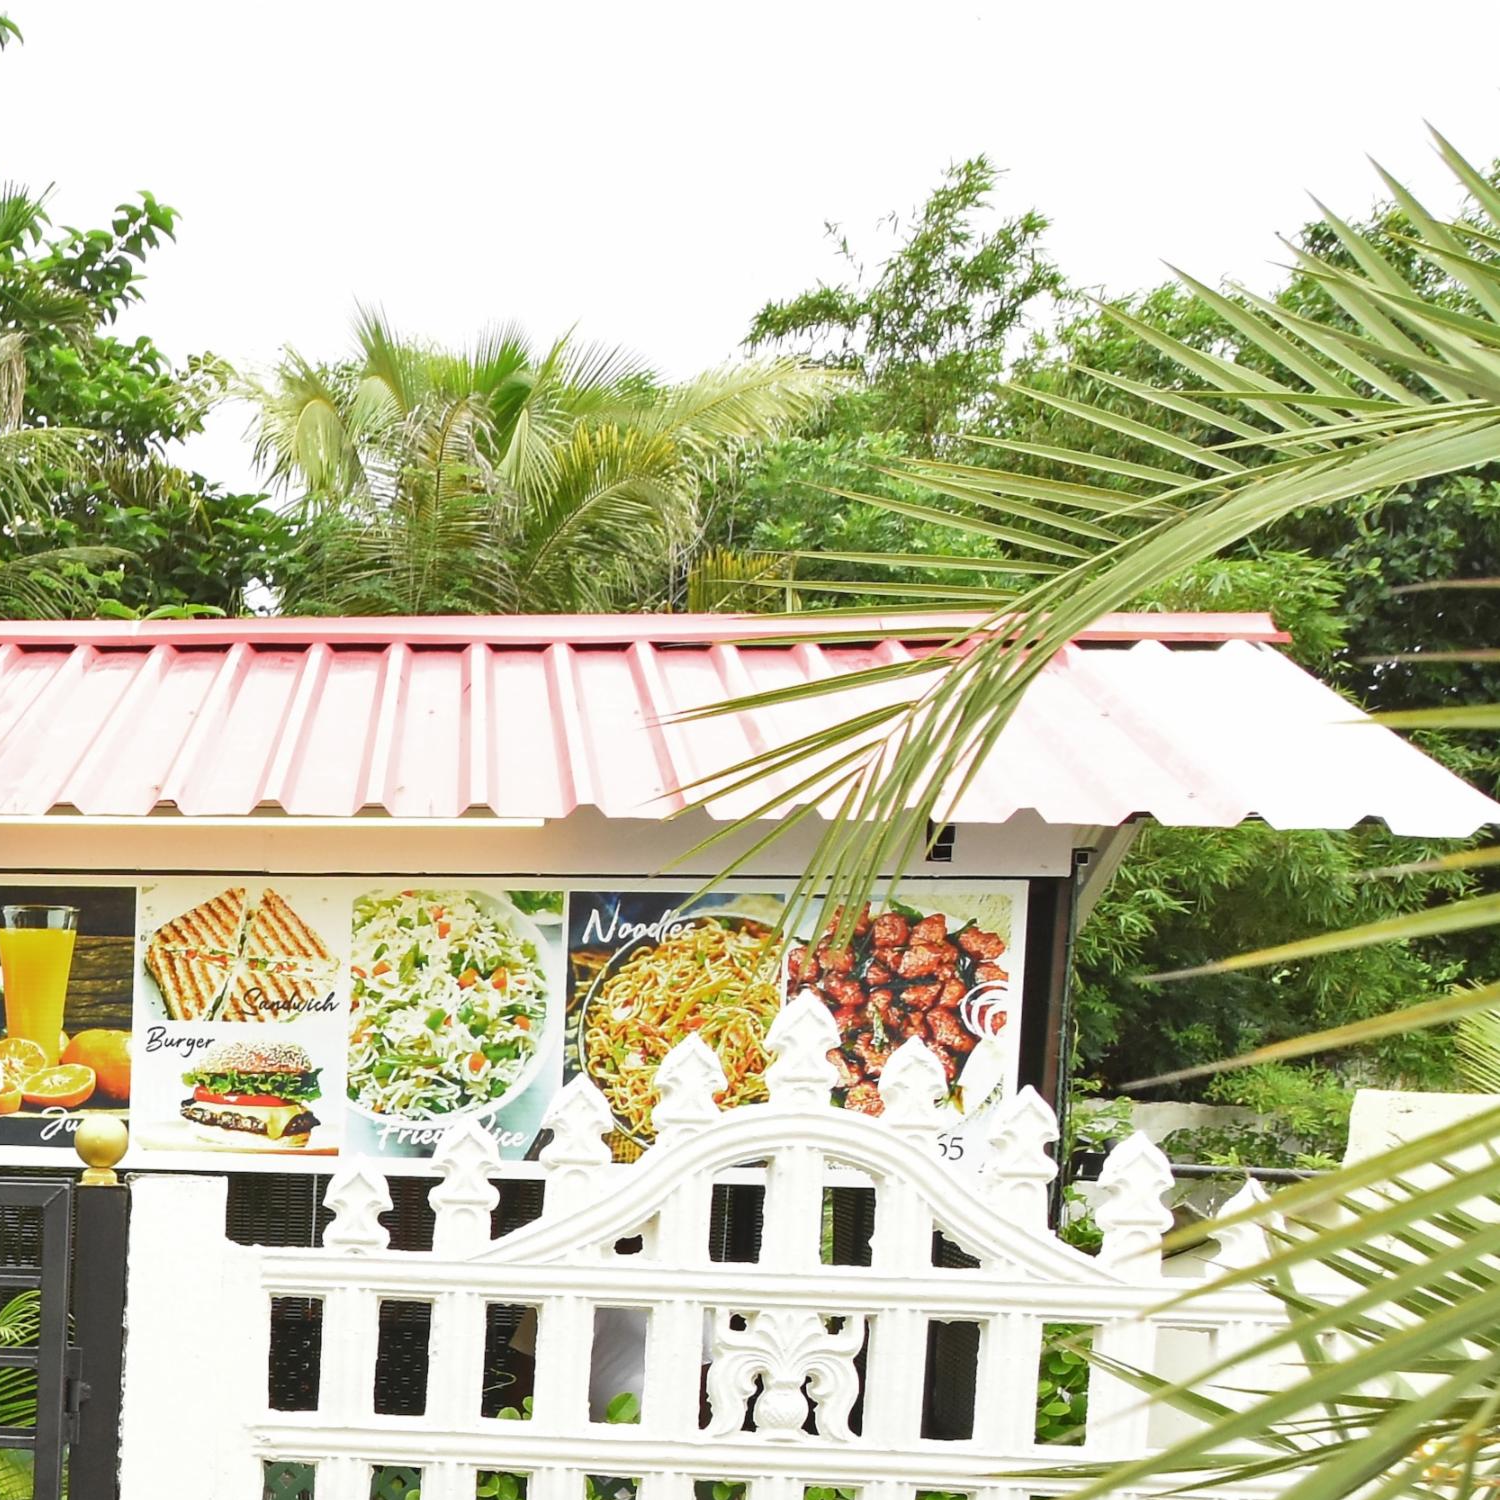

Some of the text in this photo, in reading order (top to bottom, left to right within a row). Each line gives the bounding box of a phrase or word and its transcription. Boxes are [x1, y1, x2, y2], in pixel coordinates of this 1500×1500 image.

[582, 899, 696, 944] Noodles
[242, 987, 339, 1016] Sandwich
[146, 1026, 215, 1058] Burger
